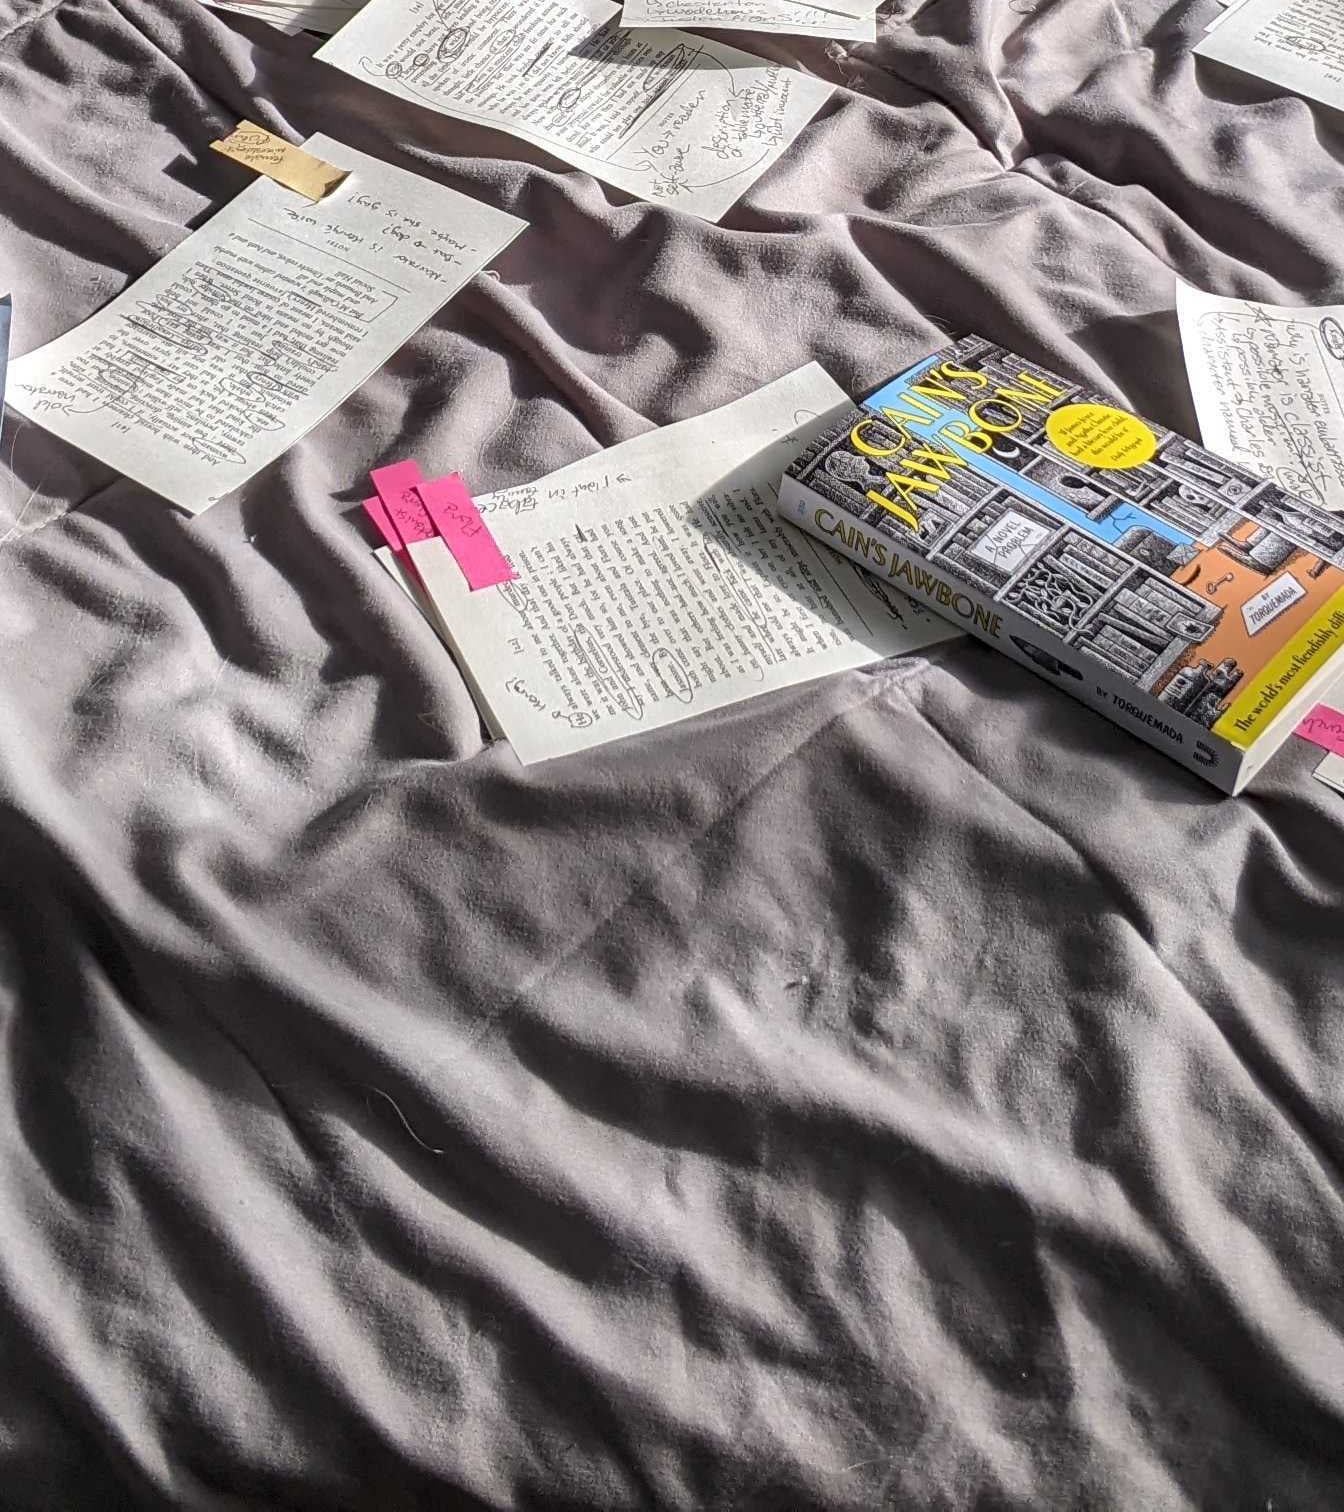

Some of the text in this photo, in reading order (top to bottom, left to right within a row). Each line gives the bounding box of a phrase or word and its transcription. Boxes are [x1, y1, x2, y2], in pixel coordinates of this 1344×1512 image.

[847, 357, 990, 460] CAIN'S
[866, 370, 1068, 534] JAWBONE
[814, 508, 1002, 637] CAIN'S JAWBONE
[984, 520, 1020, 553] A NOVEL
[995, 526, 1031, 558] PROBLEM
[1250, 587, 1295, 628] TORQUEMADA
[1233, 713, 1256, 731] The
[1252, 683, 1283, 714] world's
[1278, 662, 1301, 685] most
[1291, 628, 1337, 665] fiendishly
[1112, 694, 1182, 743] TORQUEMADA
